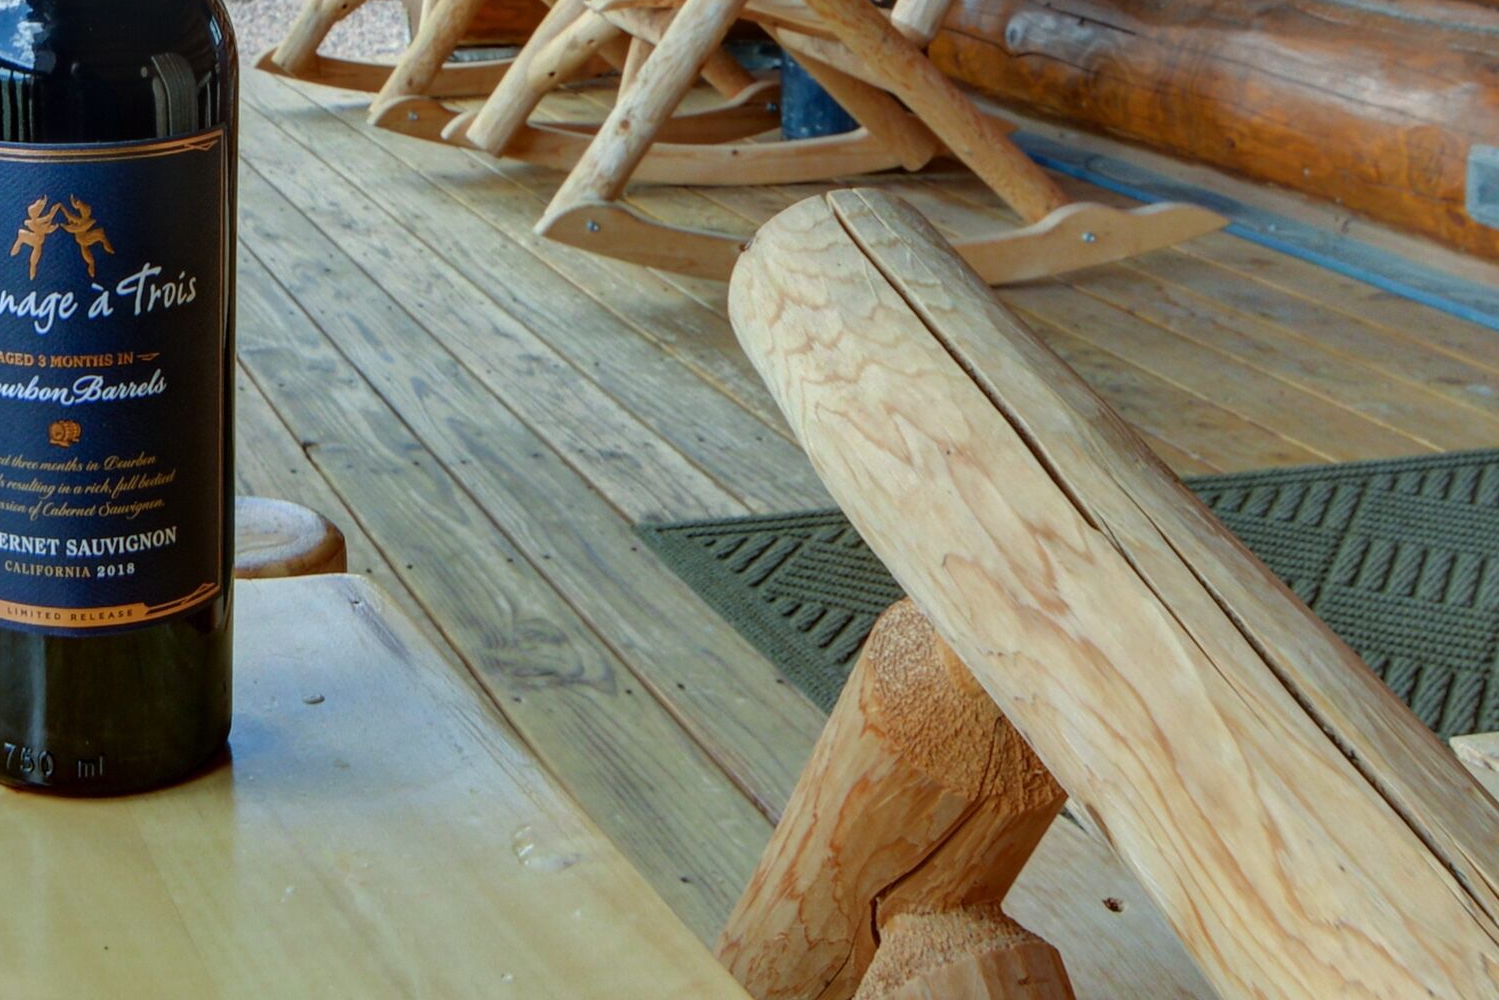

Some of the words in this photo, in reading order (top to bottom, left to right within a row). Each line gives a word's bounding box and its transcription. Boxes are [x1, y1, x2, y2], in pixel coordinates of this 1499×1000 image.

[87, 282, 114, 319] à
[116, 262, 197, 316] Trois
[37, 354, 47, 368] 3
[49, 353, 113, 369] MONTHS
[117, 351, 134, 366] IN
[72, 368, 167, 404] Barrels
[11, 454, 38, 470] three
[39, 457, 83, 472] months
[85, 460, 101, 472] in
[6, 477, 56, 500] resulting
[57, 483, 71, 494] in
[72, 485, 83, 495] a
[110, 476, 141, 500] full
[138, 468, 177, 489] bodied
[28, 500, 43, 521] of
[42, 501, 97, 518] Cabernet
[65, 525, 177, 557] SAUVIGNON
[4, 560, 91, 578] CALIFORNIA
[96, 562, 136, 578] 2018
[6, 606, 62, 620] LIMITED
[70, 608, 134, 621] RELEASE
[4, 742, 54, 778] 750
[77, 755, 104, 778] ml
